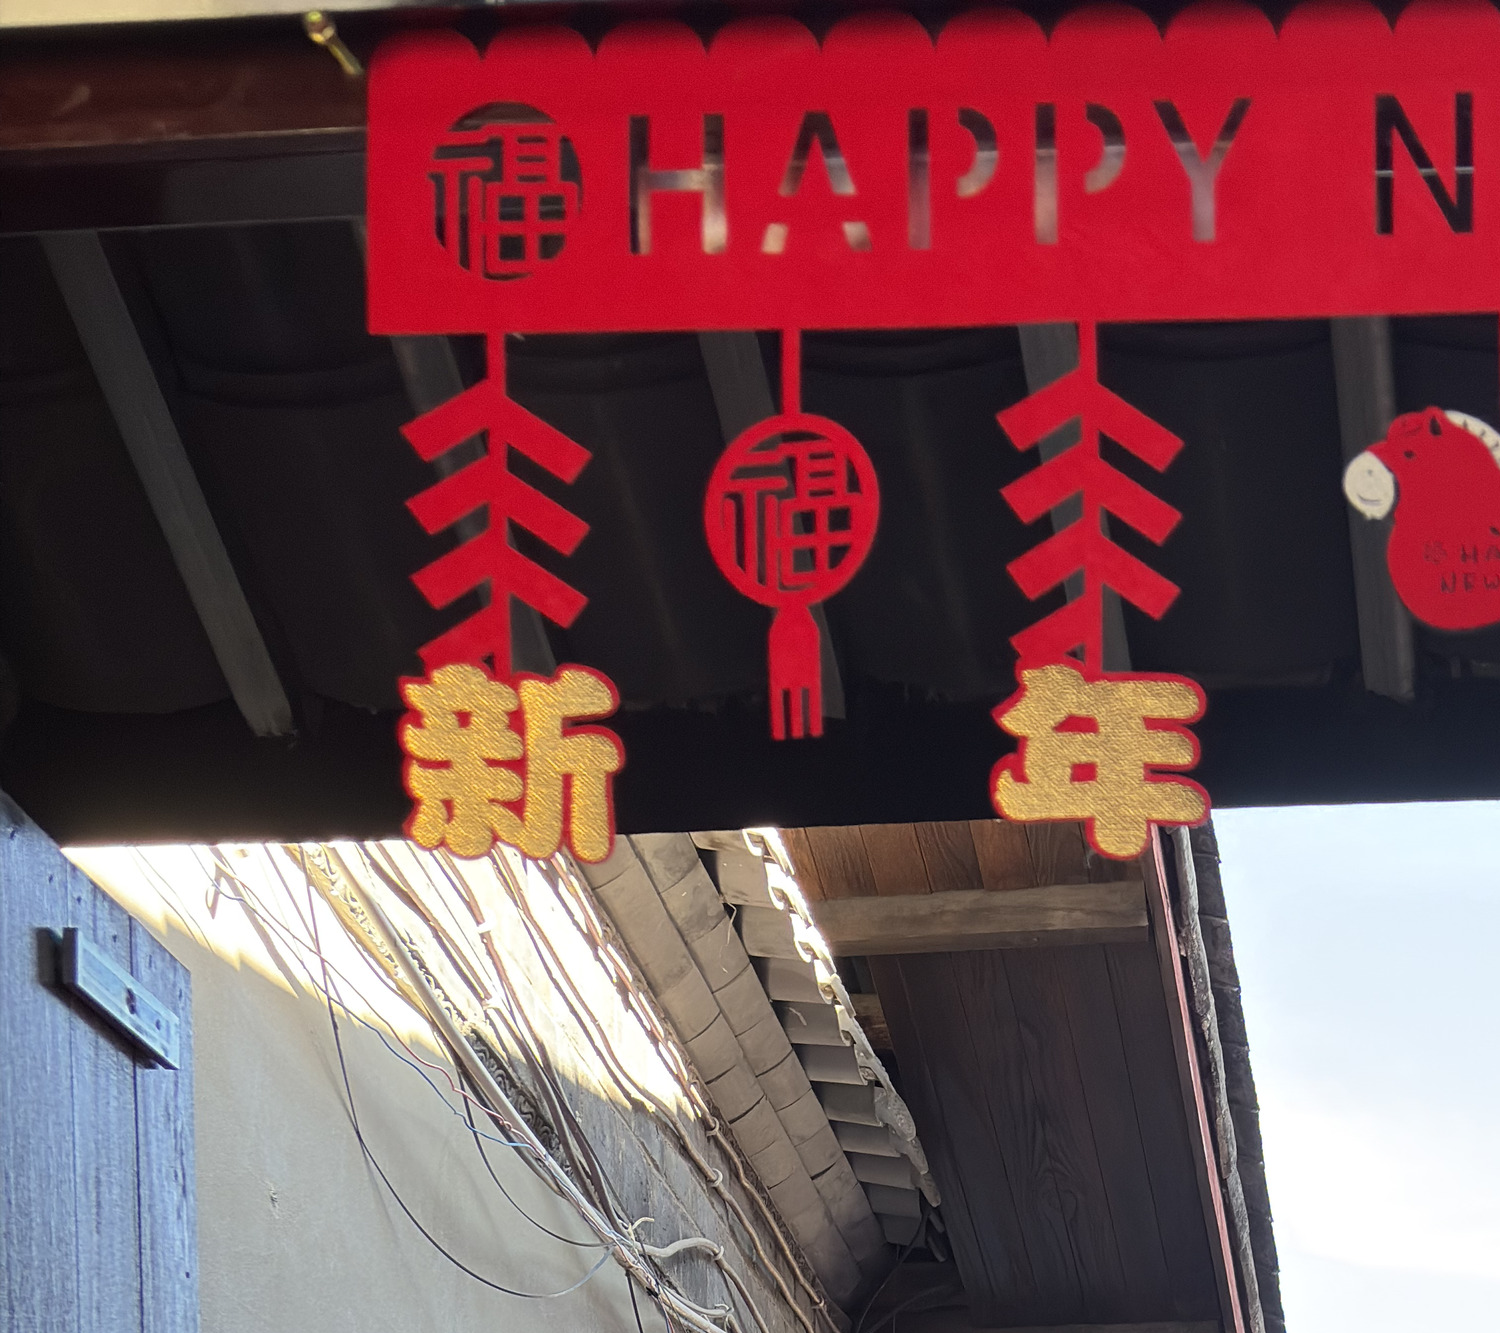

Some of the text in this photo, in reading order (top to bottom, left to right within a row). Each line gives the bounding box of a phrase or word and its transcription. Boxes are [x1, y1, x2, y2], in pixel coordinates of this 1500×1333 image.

[427, 101, 582, 280] 福
[628, 97, 1253, 256] HAPPY
[720, 428, 860, 592] 福
[1440, 572, 1500, 593] NEW
[402, 664, 624, 863] 新
[993, 664, 1209, 858] 年
